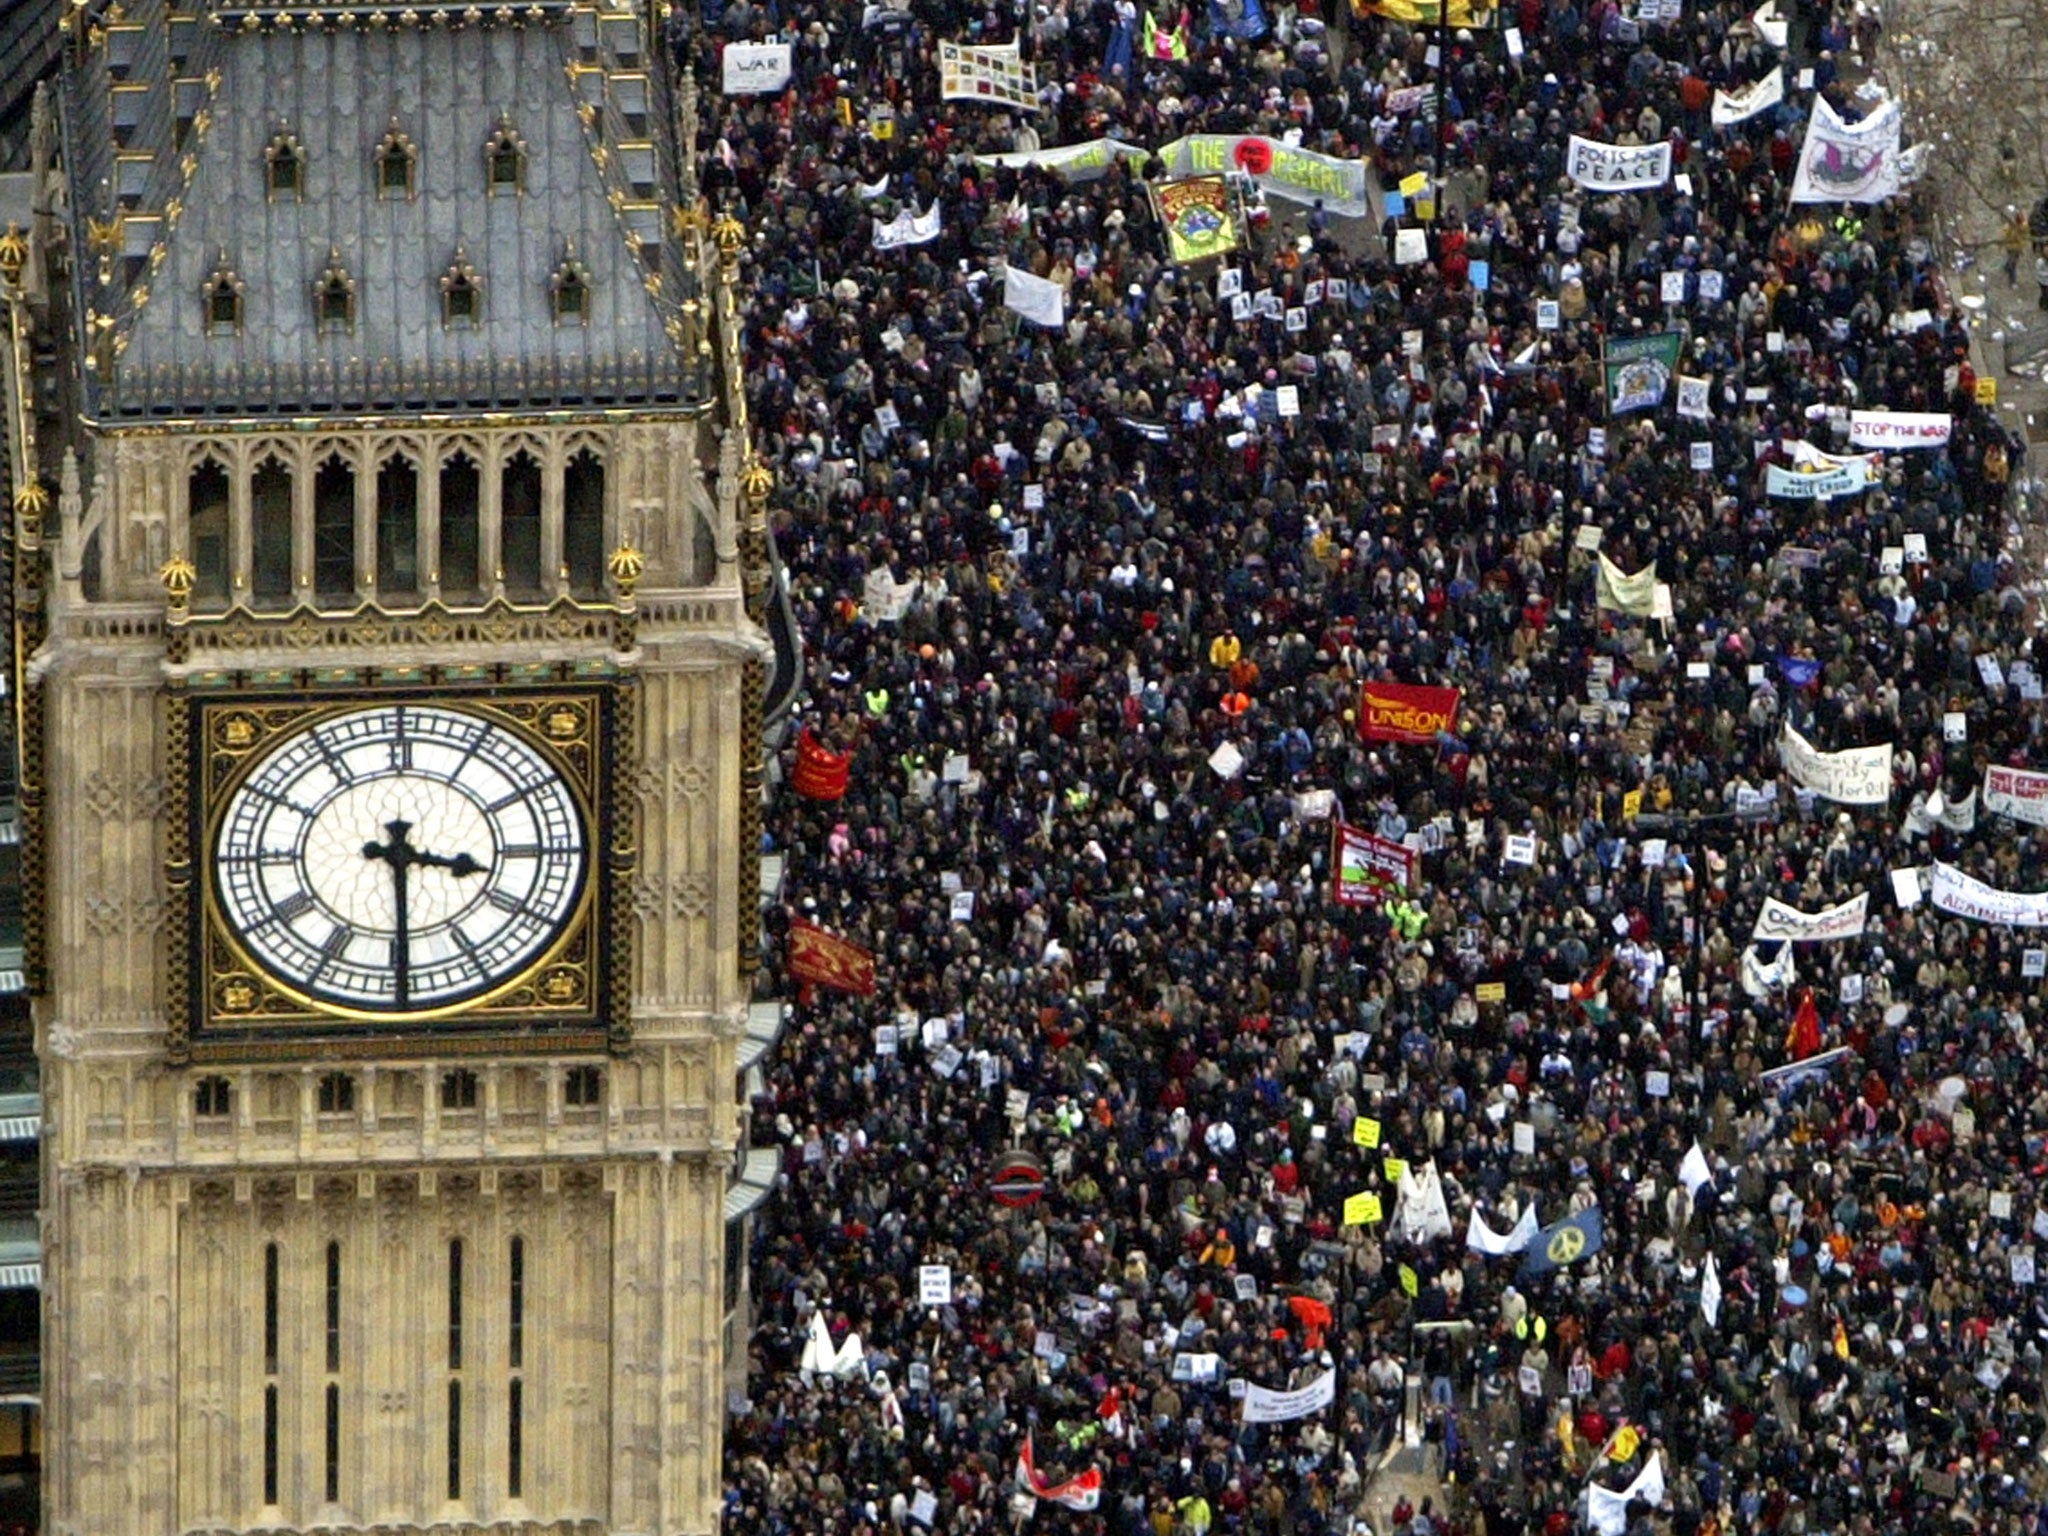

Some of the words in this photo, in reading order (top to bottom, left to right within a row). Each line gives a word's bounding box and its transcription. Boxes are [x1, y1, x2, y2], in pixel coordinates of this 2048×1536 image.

[736, 57, 780, 72] WAR
[1189, 139, 1226, 169] THE
[1577, 145, 1627, 164] POETS
[1576, 161, 1660, 181] PEACE
[1854, 422, 1891, 436] STOP
[1894, 425, 1915, 436] THE
[1920, 424, 1949, 437] WAR
[1369, 709, 1448, 734] UNISON
[1942, 893, 2024, 923] AGAINST
